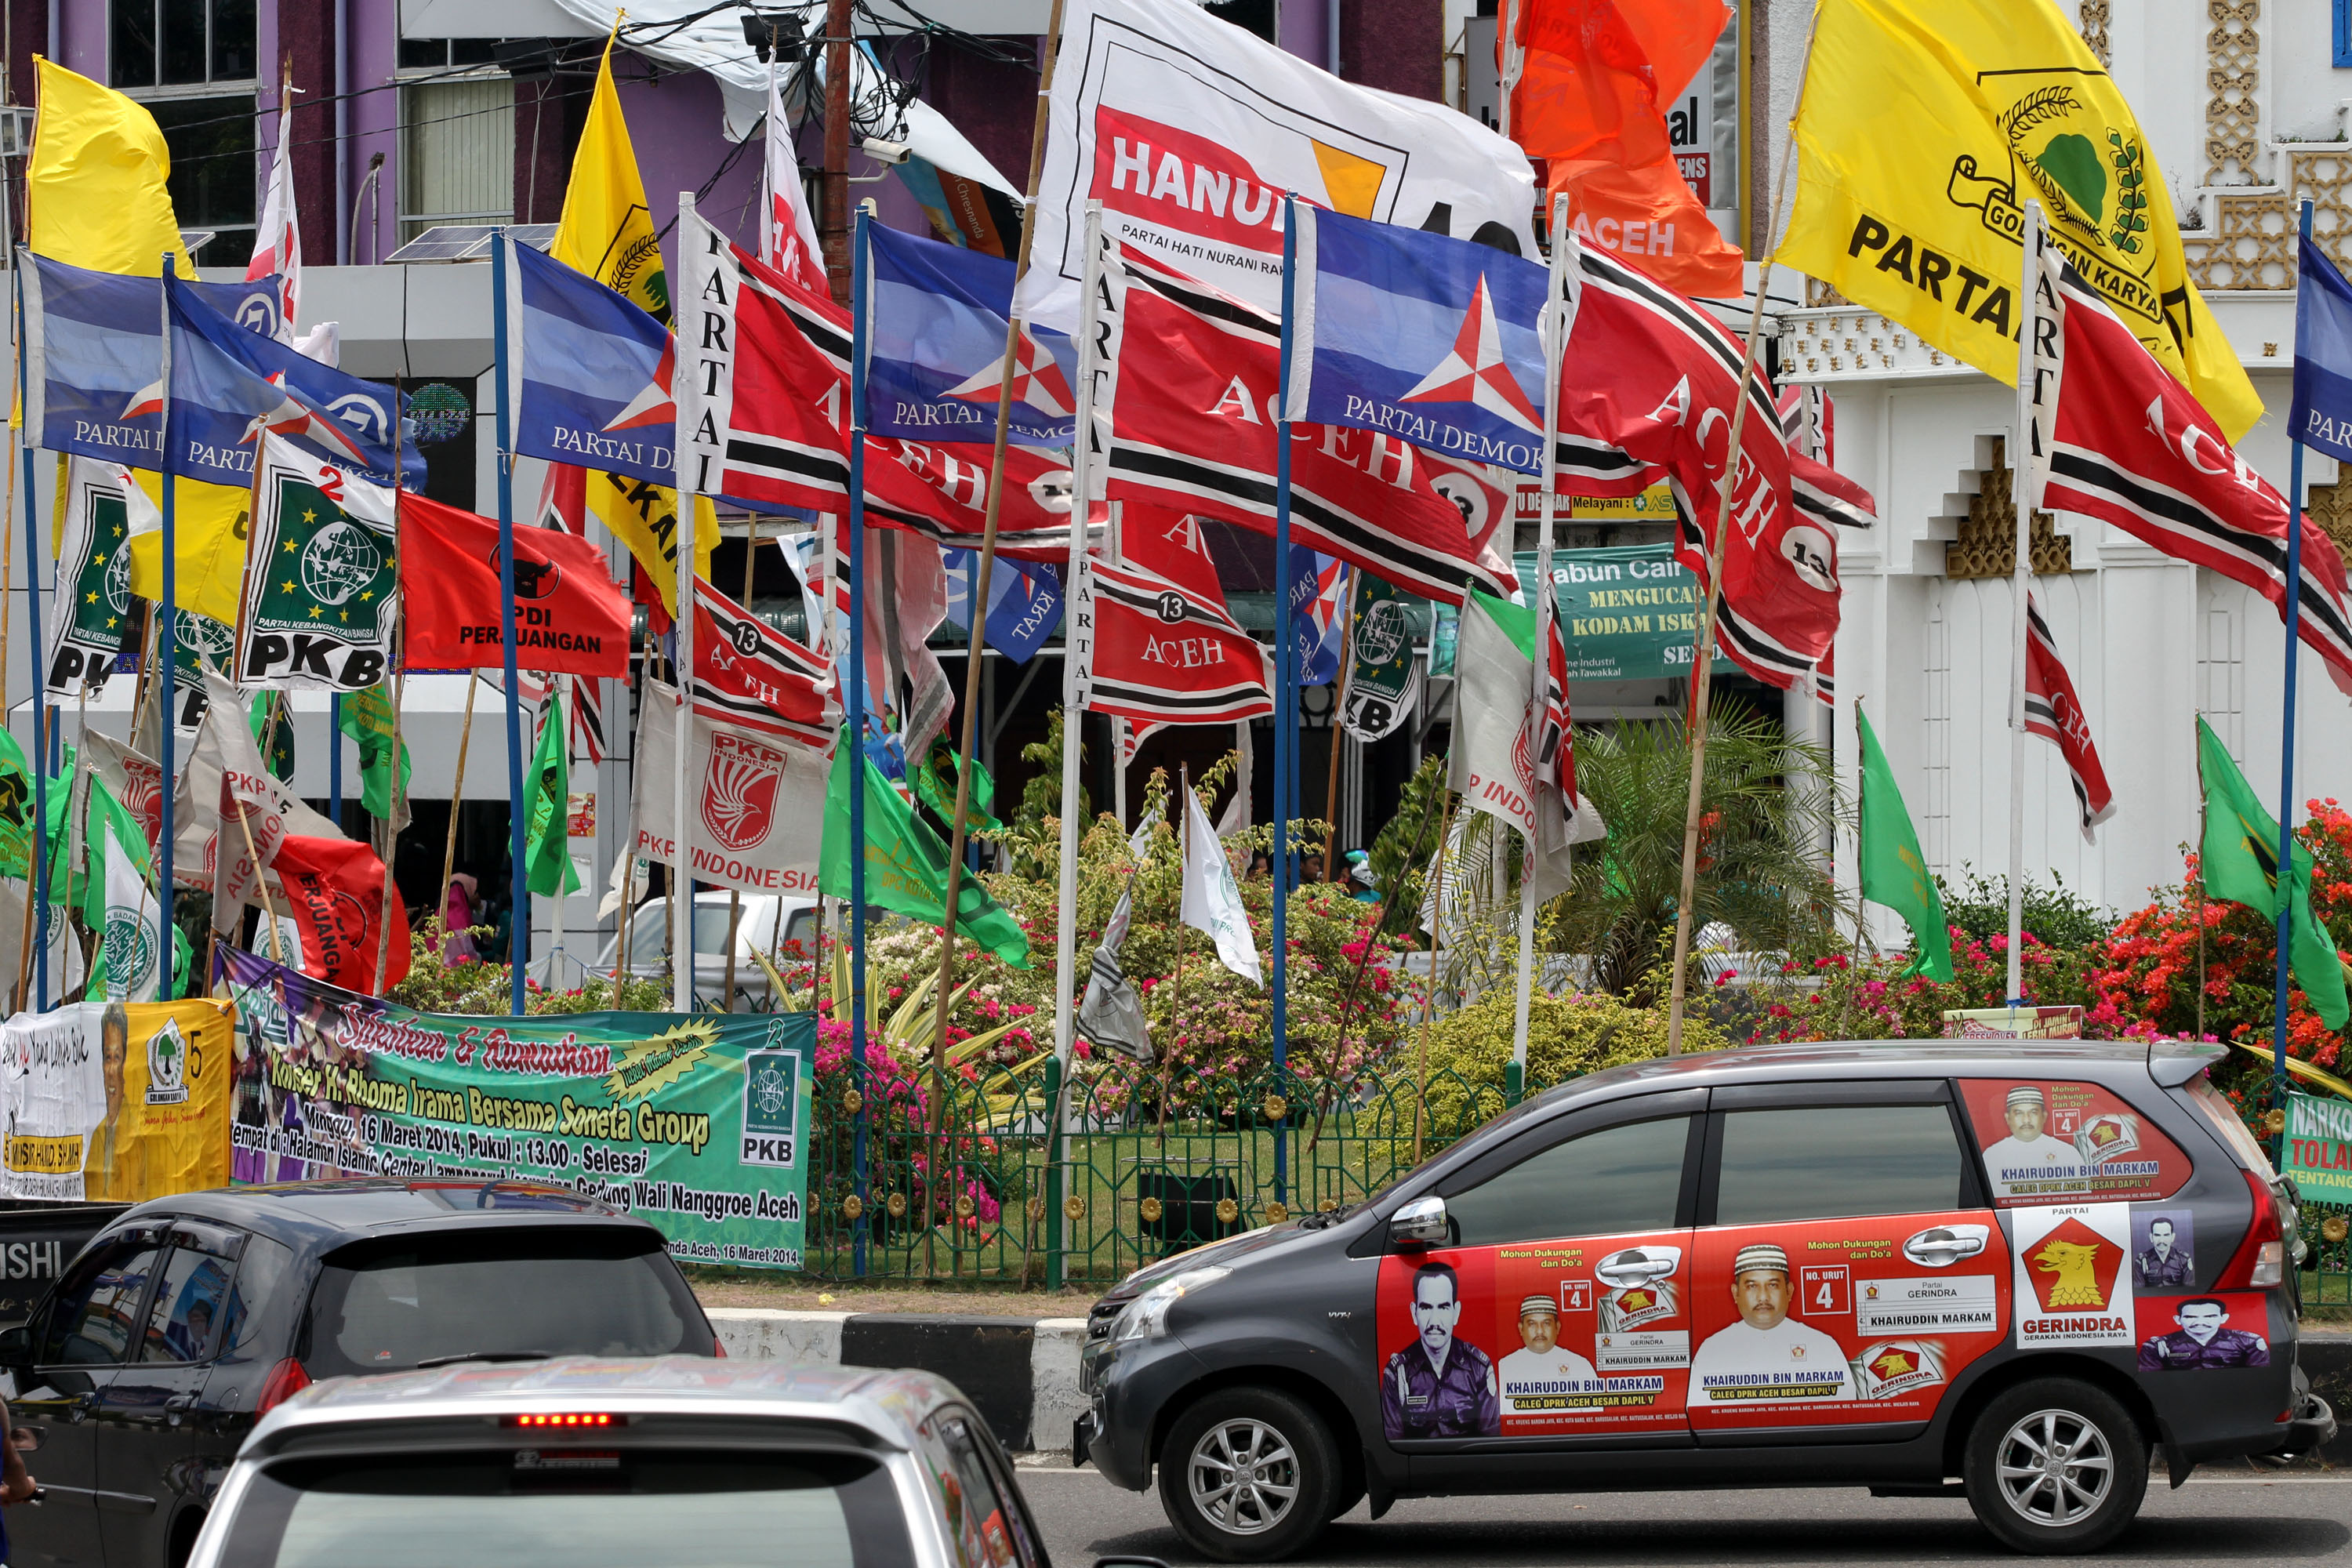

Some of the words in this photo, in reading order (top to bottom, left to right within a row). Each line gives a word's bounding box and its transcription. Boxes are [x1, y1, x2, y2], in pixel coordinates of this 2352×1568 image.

[1573, 212, 1675, 257] ACEH
[1122, 223, 1168, 249] PARTAI
[1171, 240, 1203, 260] HATI
[1207, 249, 1258, 271] NURANI
[2093, 265, 2158, 317] KARYA
[892, 401, 984, 428] PARTAI
[1343, 394, 1438, 444] PARTAI
[74, 420, 150, 450] PARTAI
[551, 426, 644, 466] PARTAI
[318, 465, 345, 503] 2
[1573, 496, 1623, 511] Melayani
[514, 606, 551, 627] PDI
[1160, 595, 1183, 619] 13
[259, 618, 291, 629] PARTAI
[292, 620, 353, 639] KEBANGKITAN
[353, 628, 374, 639] BANGSA
[1074, 561, 1093, 704] PARTAI
[1572, 614, 1651, 637] KODAM
[460, 625, 601, 655] PERUANGAN
[737, 626, 757, 652] 13
[247, 633, 385, 688] PKB
[1141, 633, 1225, 670] ACEH
[1580, 657, 1615, 667] Industri
[1580, 667, 1621, 678] Tawakkal
[1372, 680, 1397, 697] BANGSA
[715, 732, 783, 763] PKP
[713, 748, 779, 773] INDONESIA
[227, 771, 267, 796] PKP
[639, 829, 675, 857] PKP
[114, 911, 138, 924] BADAN
[765, 1019, 784, 1050] 2
[191, 1030, 202, 1079] 5
[271, 1048, 322, 1097] Konser
[324, 1062, 342, 1103] H.
[346, 1067, 408, 1115] Rhoma
[410, 1076, 466, 1123] Irama
[467, 1086, 557, 1134] Bersama
[560, 1095, 632, 1142] Soneta
[636, 1100, 710, 1156] Group
[2061, 1118, 2071, 1132] 4
[230, 1120, 268, 1156] tempat
[270, 1127, 281, 1153] di
[289, 1129, 335, 1165] Halaman
[337, 1144, 379, 1174] Islamic
[380, 1149, 426, 1177] Center
[303, 1104, 356, 1141] Minggu,
[361, 1116, 376, 1142] 16
[380, 1119, 423, 1149] Maret
[426, 1127, 466, 1160] 2014,
[468, 1133, 511, 1161] Pukul
[526, 1139, 568, 1167] 13.00
[583, 1144, 648, 1175] Selesai
[744, 1138, 793, 1163] PKB
[2001, 1166, 2075, 1181] KHAIRUDDIN
[2079, 1164, 2100, 1177] BIN
[2103, 1161, 2158, 1175] MARKAM
[2009, 1185, 2037, 1194] CALEG
[2063, 1181, 2086, 1191] ACEH
[2089, 1180, 2115, 1189] BESAR
[2118, 1178, 2142, 1189] DAPIL
[633, 1180, 666, 1209] Wali
[672, 1184, 753, 1221] Nanggroe
[757, 1189, 799, 1220] Aceh
[690, 1242, 720, 1261] Aceh,
[724, 1247, 735, 1259] 16
[739, 1247, 769, 1262] Maret
[1501, 1249, 1533, 1259] Mohon
[1534, 1248, 1582, 1260] Dukungan
[1808, 1240, 1842, 1250] Mohon
[1842, 1239, 1892, 1251] Dukungan
[1849, 1250, 1868, 1260] dan
[1870, 1250, 1892, 1259] Do'a
[1541, 1259, 1559, 1269] dan
[1561, 1258, 1582, 1269] Do'a
[1806, 1272, 1820, 1281] NO.
[1822, 1270, 1845, 1280] URUT
[1922, 1280, 1943, 1290] Partai
[1570, 1291, 1581, 1308] 4
[1816, 1283, 1834, 1309] 4
[1907, 1289, 1958, 1300] GERINDRA
[1618, 1305, 1669, 1325] GERINDRA
[1871, 1315, 1940, 1327] KHAIRUDDIN
[1942, 1312, 1992, 1325] MARKAM
[2024, 1317, 2127, 1334] GERINDRA
[1653, 1355, 1687, 1363] MARKAM
[1506, 1379, 1581, 1394] KHAIRUDDIN
[1584, 1378, 1604, 1392] BIN
[1608, 1377, 1663, 1391] MARKAM
[1703, 1372, 1769, 1386] KHAIRUDDIN
[1773, 1371, 1793, 1385] BIN
[1795, 1370, 1844, 1383] MARKAM
[1871, 1371, 1933, 1395] GERINDRA
[1514, 1399, 1541, 1409] CALEG
[1543, 1398, 1566, 1408] DPRK
[1568, 1397, 1591, 1407] ACEH
[1592, 1396, 1620, 1406] BESAR
[1621, 1396, 1646, 1406] DAPIL
[1647, 1395, 1654, 1404] V
[1710, 1390, 1735, 1399] CALEG
[1737, 1389, 1759, 1399] DPRK
[1759, 1388, 1780, 1398] ACEH
[1781, 1388, 1806, 1397] BESAR
[1807, 1387, 1831, 1396] DAPIL
[1831, 1386, 1837, 1396] V
